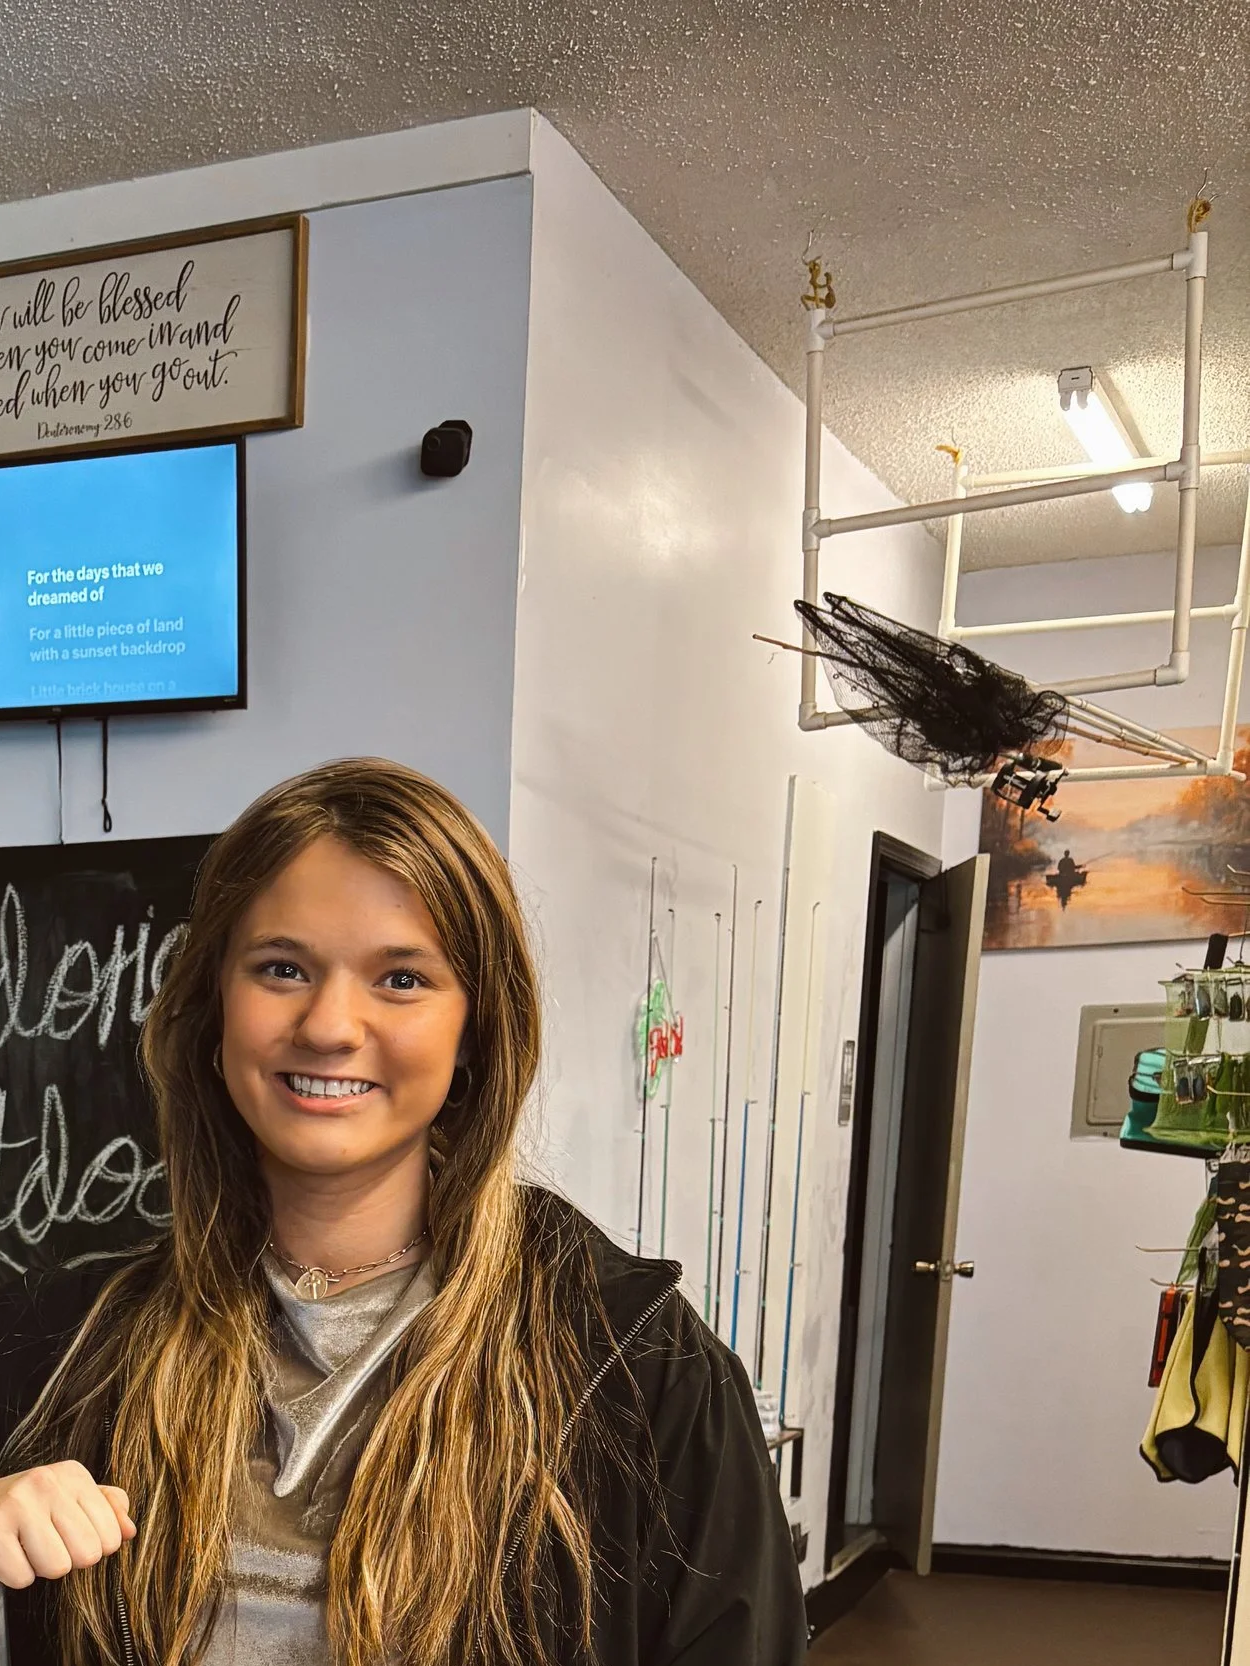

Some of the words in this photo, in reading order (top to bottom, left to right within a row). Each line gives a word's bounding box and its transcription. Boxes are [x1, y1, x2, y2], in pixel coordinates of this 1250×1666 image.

[13, 279, 55, 329] will
[62, 277, 93, 327] be
[100, 260, 194, 324] blessed
[35, 336, 82, 374] you
[83, 337, 145, 363] come
[149, 320, 181, 349] in
[180, 295, 241, 349] and
[31, 364, 95, 408] when
[100, 372, 146, 409] you
[152, 357, 189, 401] go
[183, 349, 238, 391] out.
[37, 422, 101, 440] Deuteronomy
[27, 570, 49, 585] For
[52, 567, 74, 583] the
[76, 565, 109, 583] days
[112, 562, 140, 578] that
[143, 562, 164, 576] we
[28, 587, 87, 606] dreamed
[90, 586, 104, 601] of
[29, 627, 50, 641] For
[54, 629, 61, 639] a
[64, 624, 94, 639] little
[97, 622, 133, 639] piece
[137, 619, 150, 633] of
[154, 617, 183, 632] land
[30, 647, 58, 662] with
[61, 649, 69, 660] a
[72, 645, 118, 659] sunset
[121, 640, 186, 656] backdrop
[31, 685, 64, 698] Little
[67, 683, 100, 697] brick
[104, 681, 146, 697] house
[148, 682, 165, 693] on
